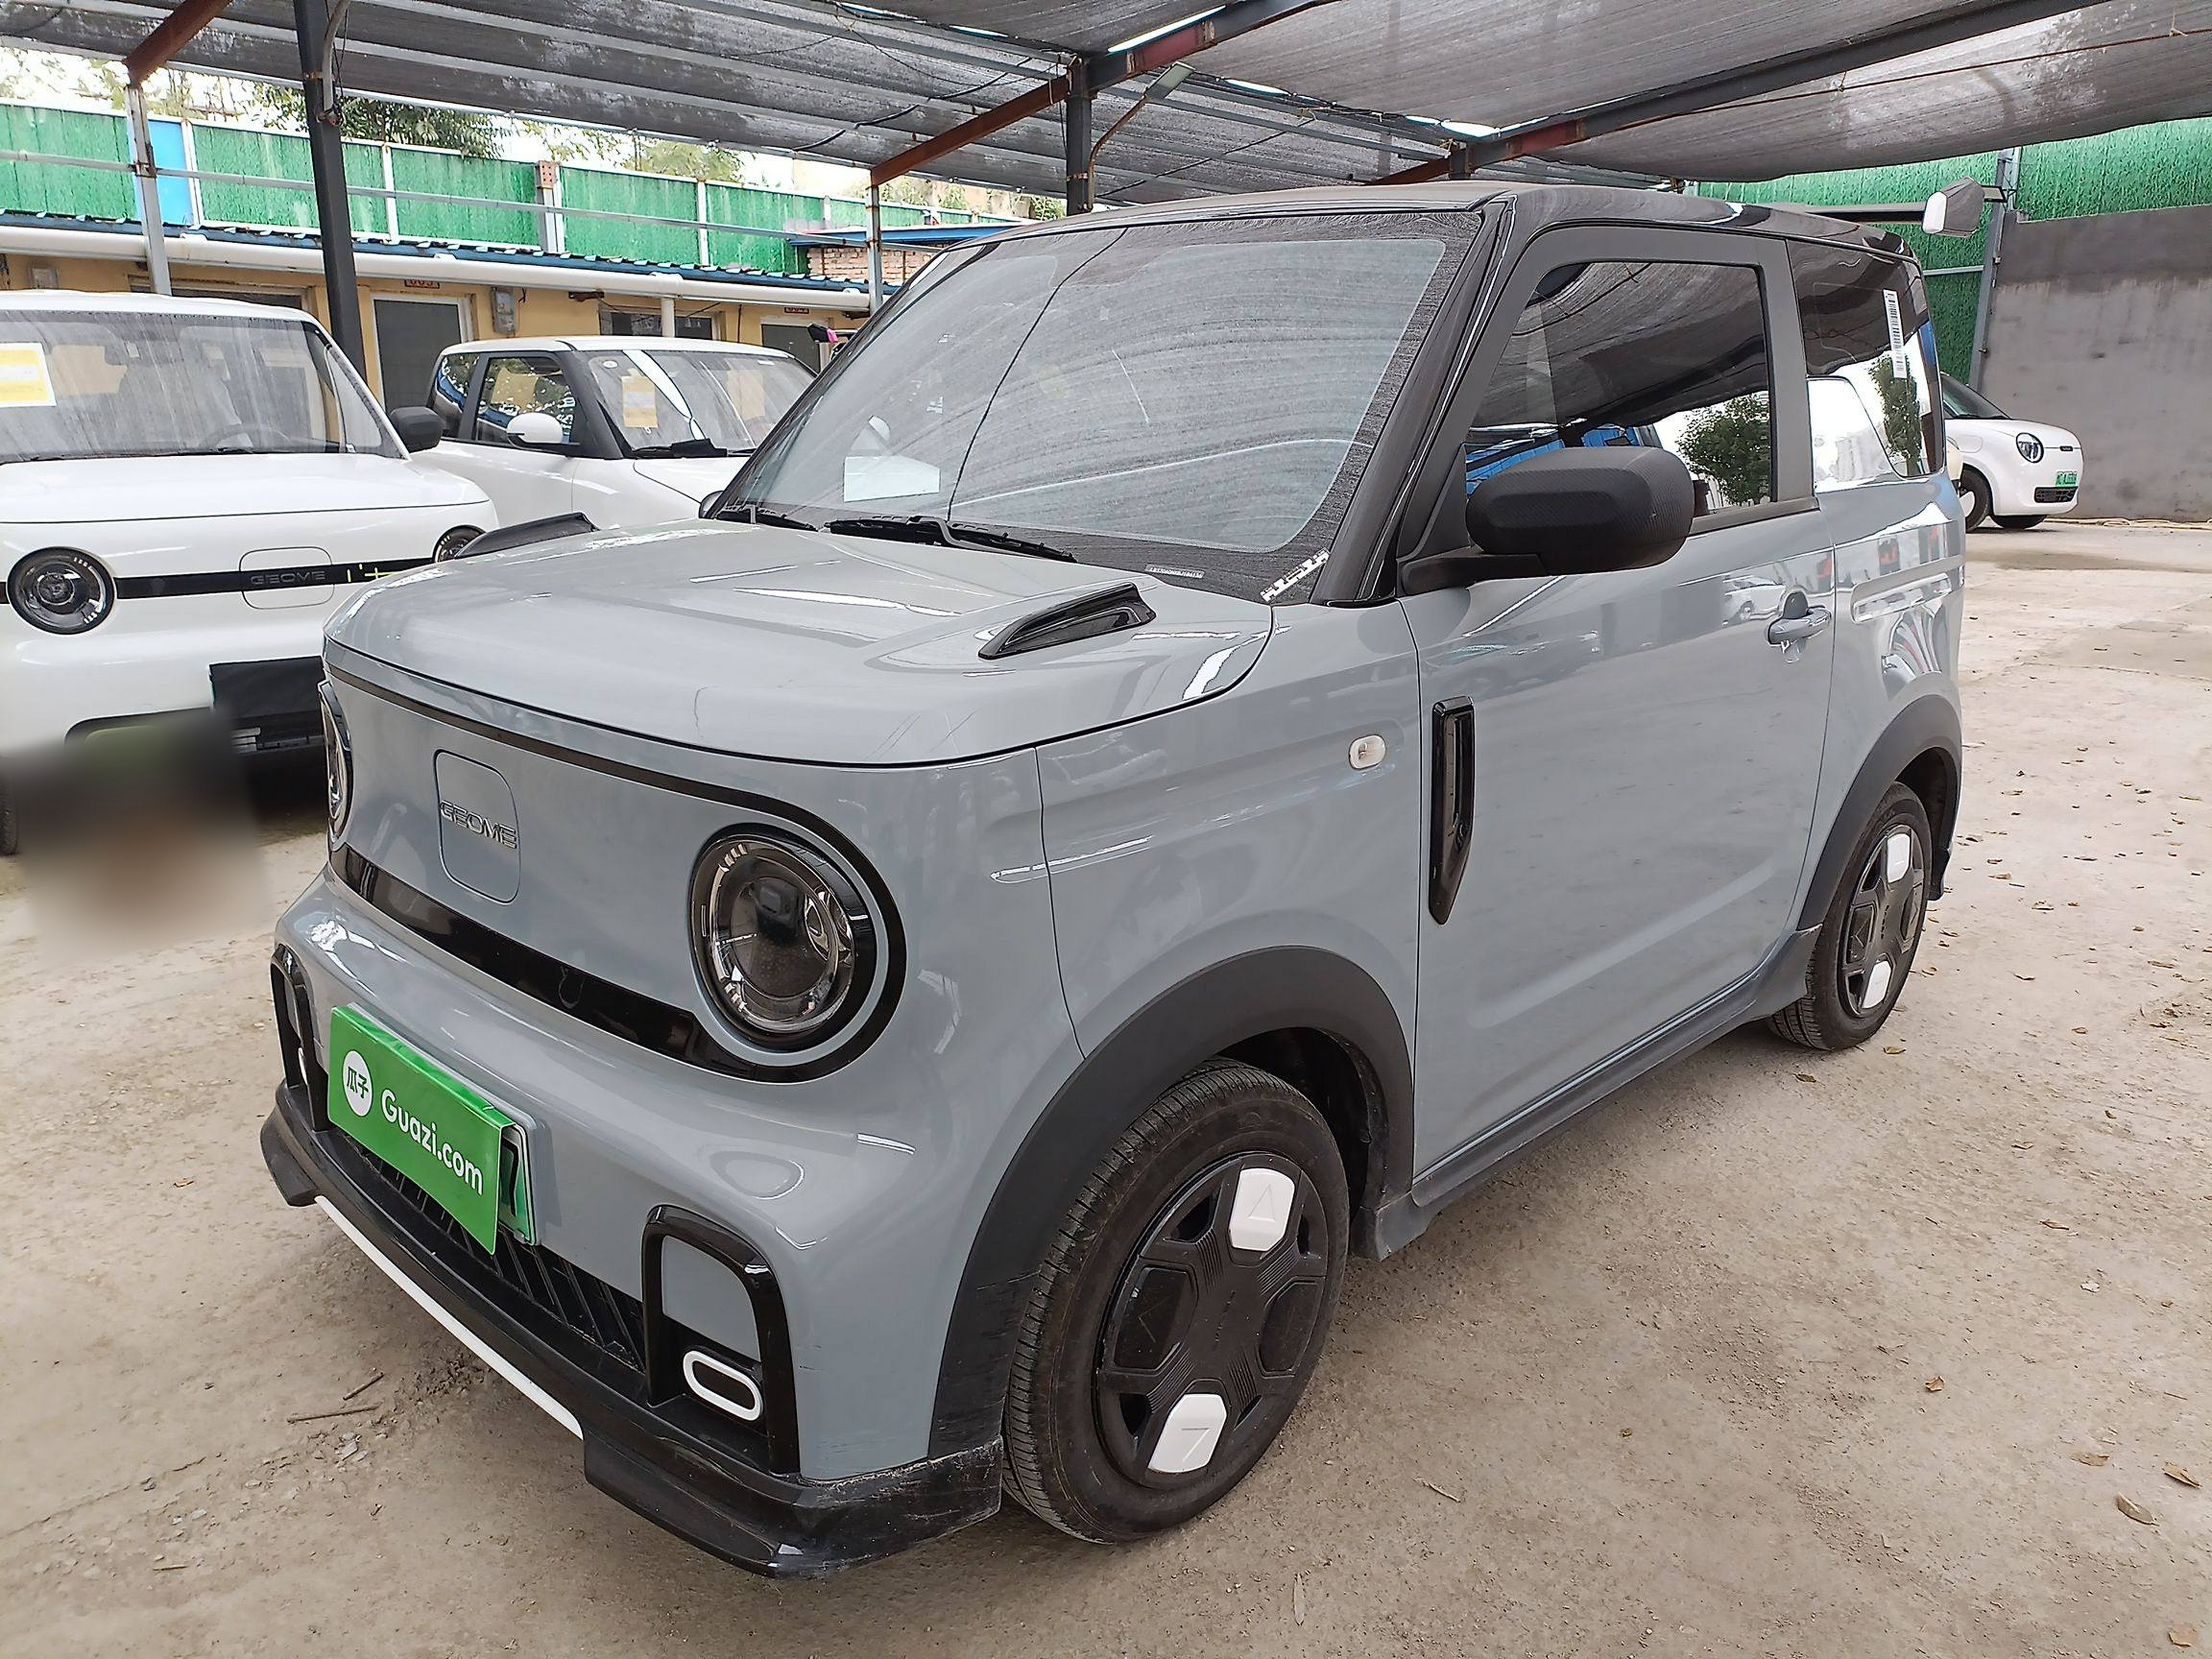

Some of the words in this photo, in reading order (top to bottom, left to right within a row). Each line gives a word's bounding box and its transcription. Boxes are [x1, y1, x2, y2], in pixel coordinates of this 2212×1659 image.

[440, 800, 517, 849] GEOME
[346, 1066, 369, 1099] 瓜子
[381, 1089, 483, 1196] Guazi.com
